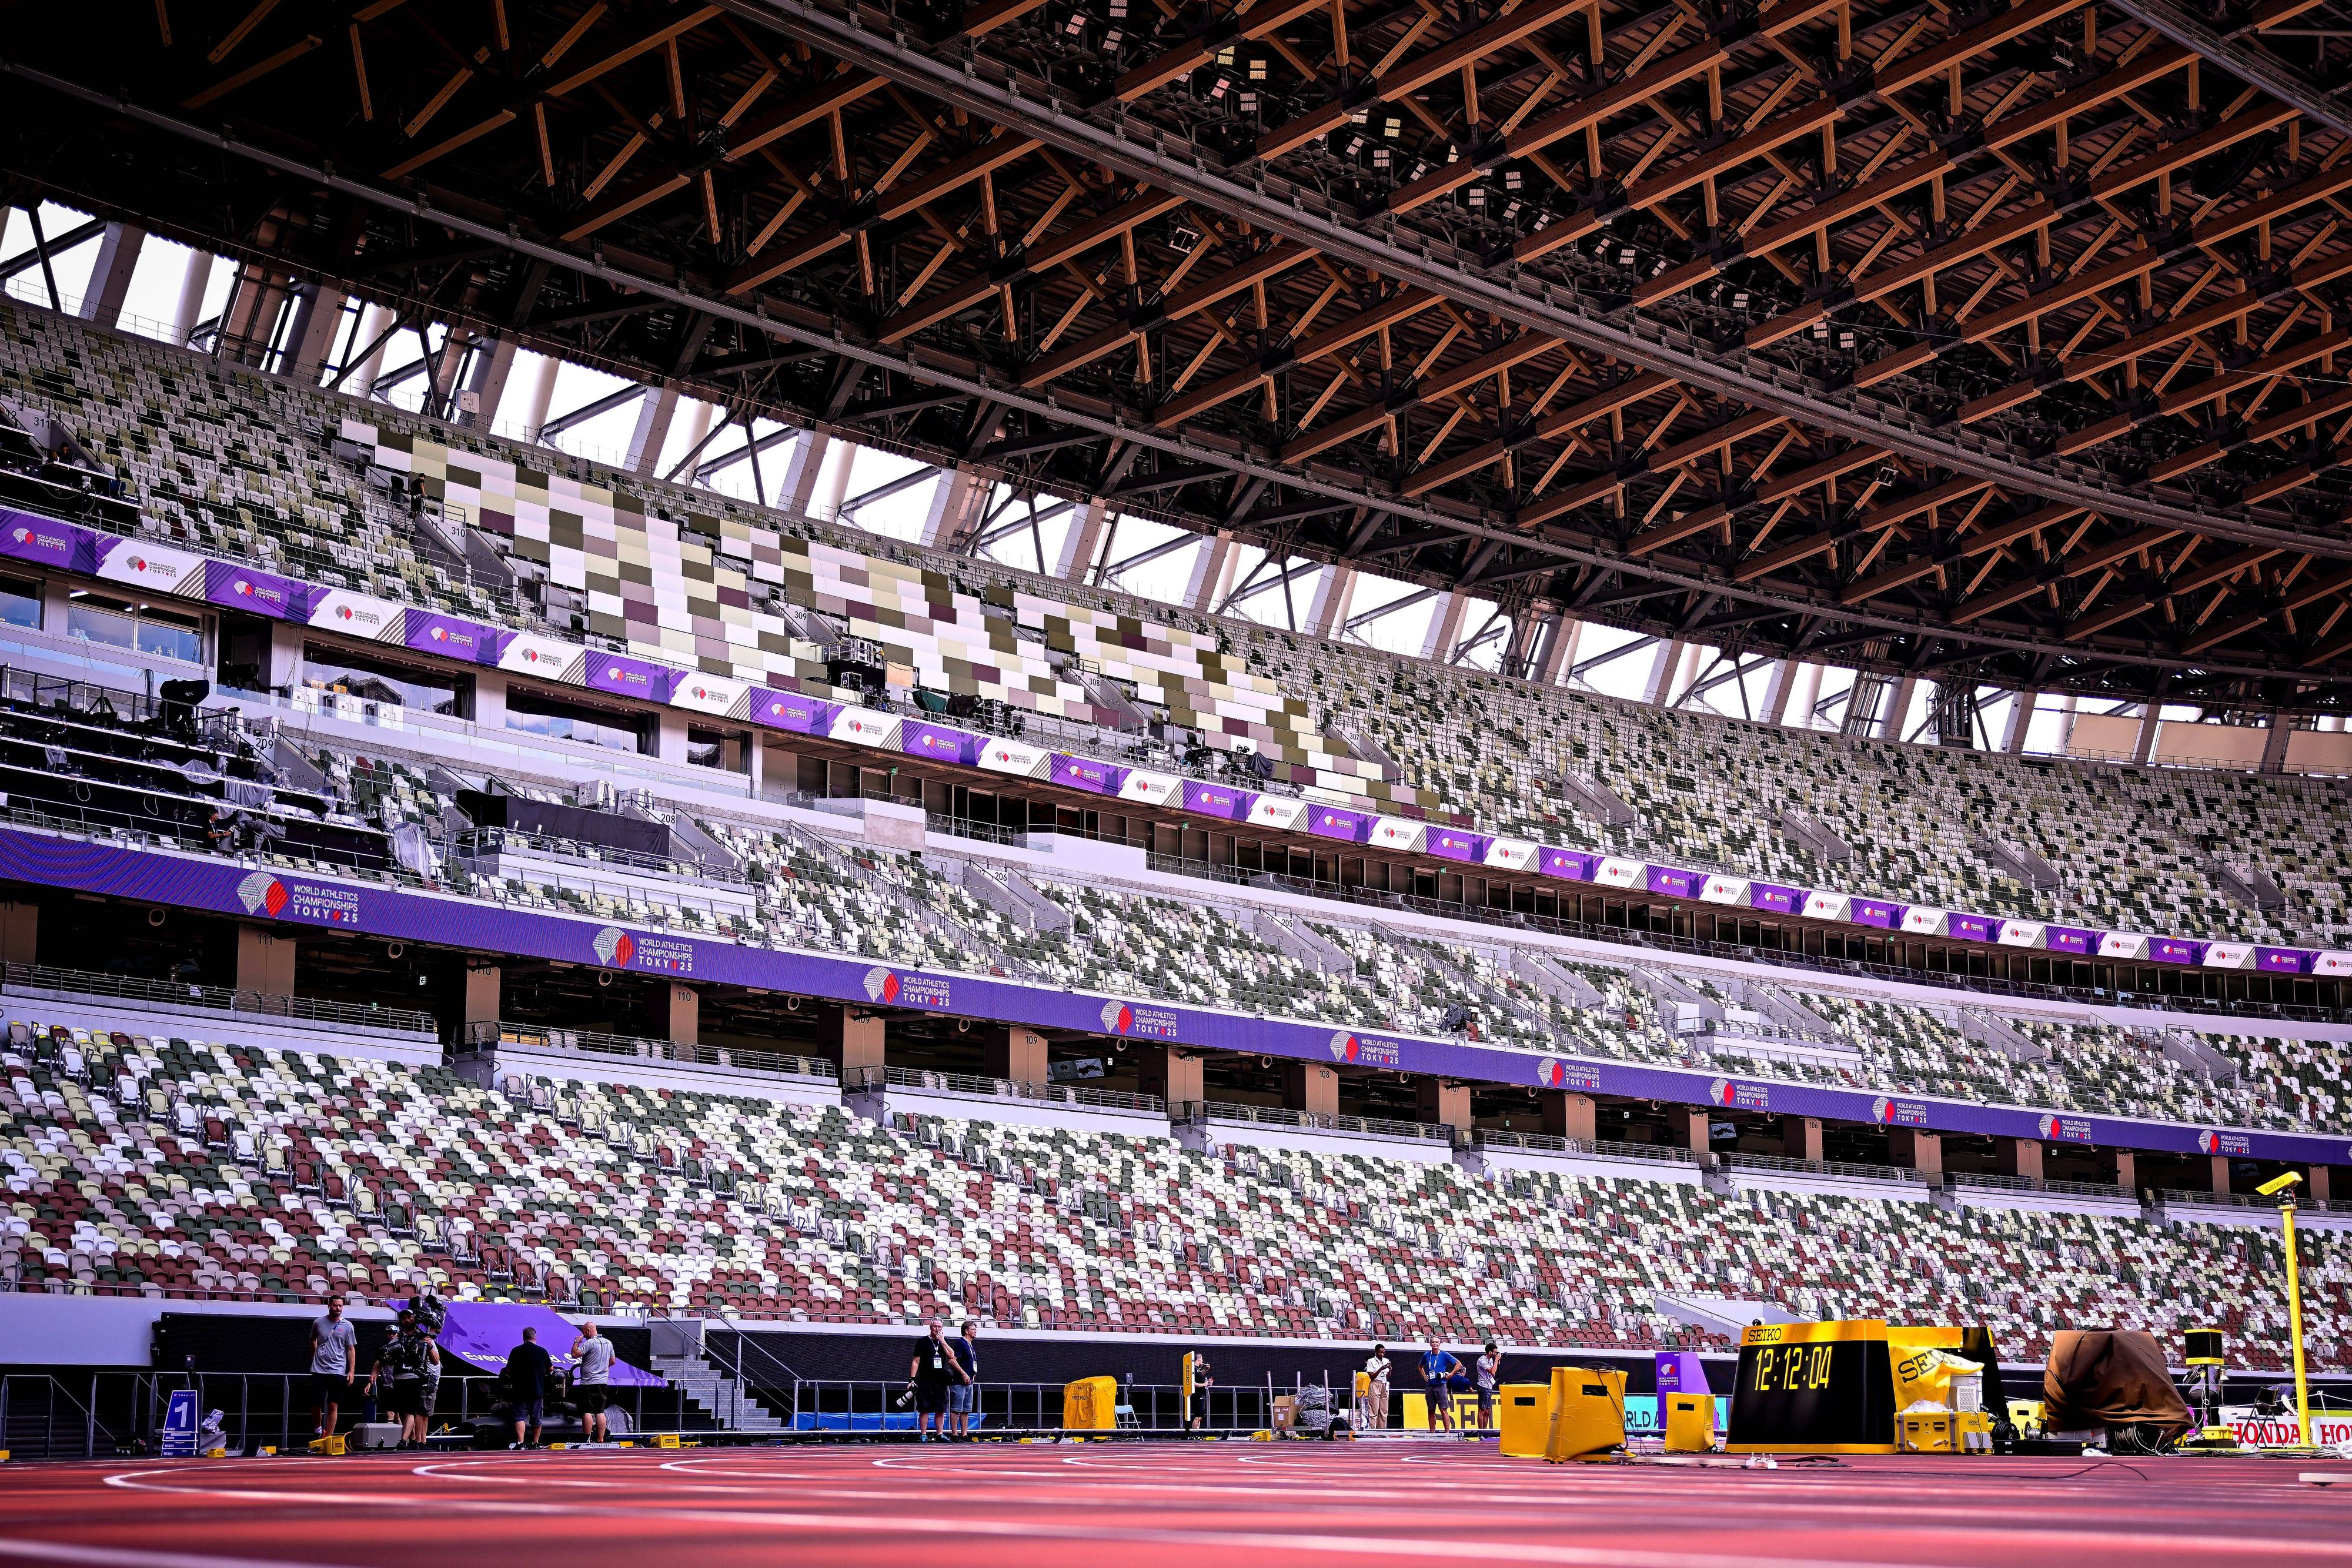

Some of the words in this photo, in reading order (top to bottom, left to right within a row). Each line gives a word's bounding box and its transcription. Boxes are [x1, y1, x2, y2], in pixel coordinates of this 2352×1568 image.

[34, 416, 51, 429] 311
[451, 526, 466, 537] 310
[794, 611, 807, 621] 309
[1089, 678, 1100, 687] 308
[255, 738, 274, 750] 209
[661, 813, 676, 824] 208
[995, 872, 1007, 881] 206
[294, 884, 319, 895] WORLD
[322, 888, 358, 902] ATHLETICS
[293, 894, 358, 912] CHAMPIONSHIPS
[1282, 919, 1292, 927] 205
[639, 937, 660, 947] WORLD
[661, 941, 692, 952] ATHLETICS
[639, 947, 692, 961] CHAMPIONSHIPS
[903, 976, 922, 985] WORLD
[923, 979, 949, 988] ATHLETICS
[677, 991, 691, 1002] 110
[903, 984, 949, 997] CHAMPIONSHIPS
[1135, 1008, 1151, 1017] WORLD
[1153, 1011, 1176, 1020] ATHLETICS
[1135, 1016, 1176, 1028] CHAMPIONSHIPS
[1025, 1035, 1038, 1045] 109
[1377, 1041, 1398, 1049] ATHLETICS
[1361, 1045, 1398, 1056] CHAMPIONSHIPS
[1319, 1070, 1330, 1079] 108
[1565, 1071, 1599, 1080] CHAMPIONSHIPS
[1736, 1091, 1768, 1099] CHAMPIONSHIPS
[1896, 1108, 1926, 1116] CHAMPIONSHIPS
[2062, 1125, 2090, 1133] CHAMPIONSHIPS
[2265, 1179, 2285, 1193] SEIKO
[1748, 1327, 1782, 1342] SEIKO
[461, 1350, 508, 1365] Every
[1755, 1346, 1832, 1391] 12:12:04
[175, 1402, 188, 1427] 1
[1626, 1410, 1651, 1427] RLD
[2226, 1422, 2301, 1445] HONDA
[2320, 1424, 2352, 1445] HO
